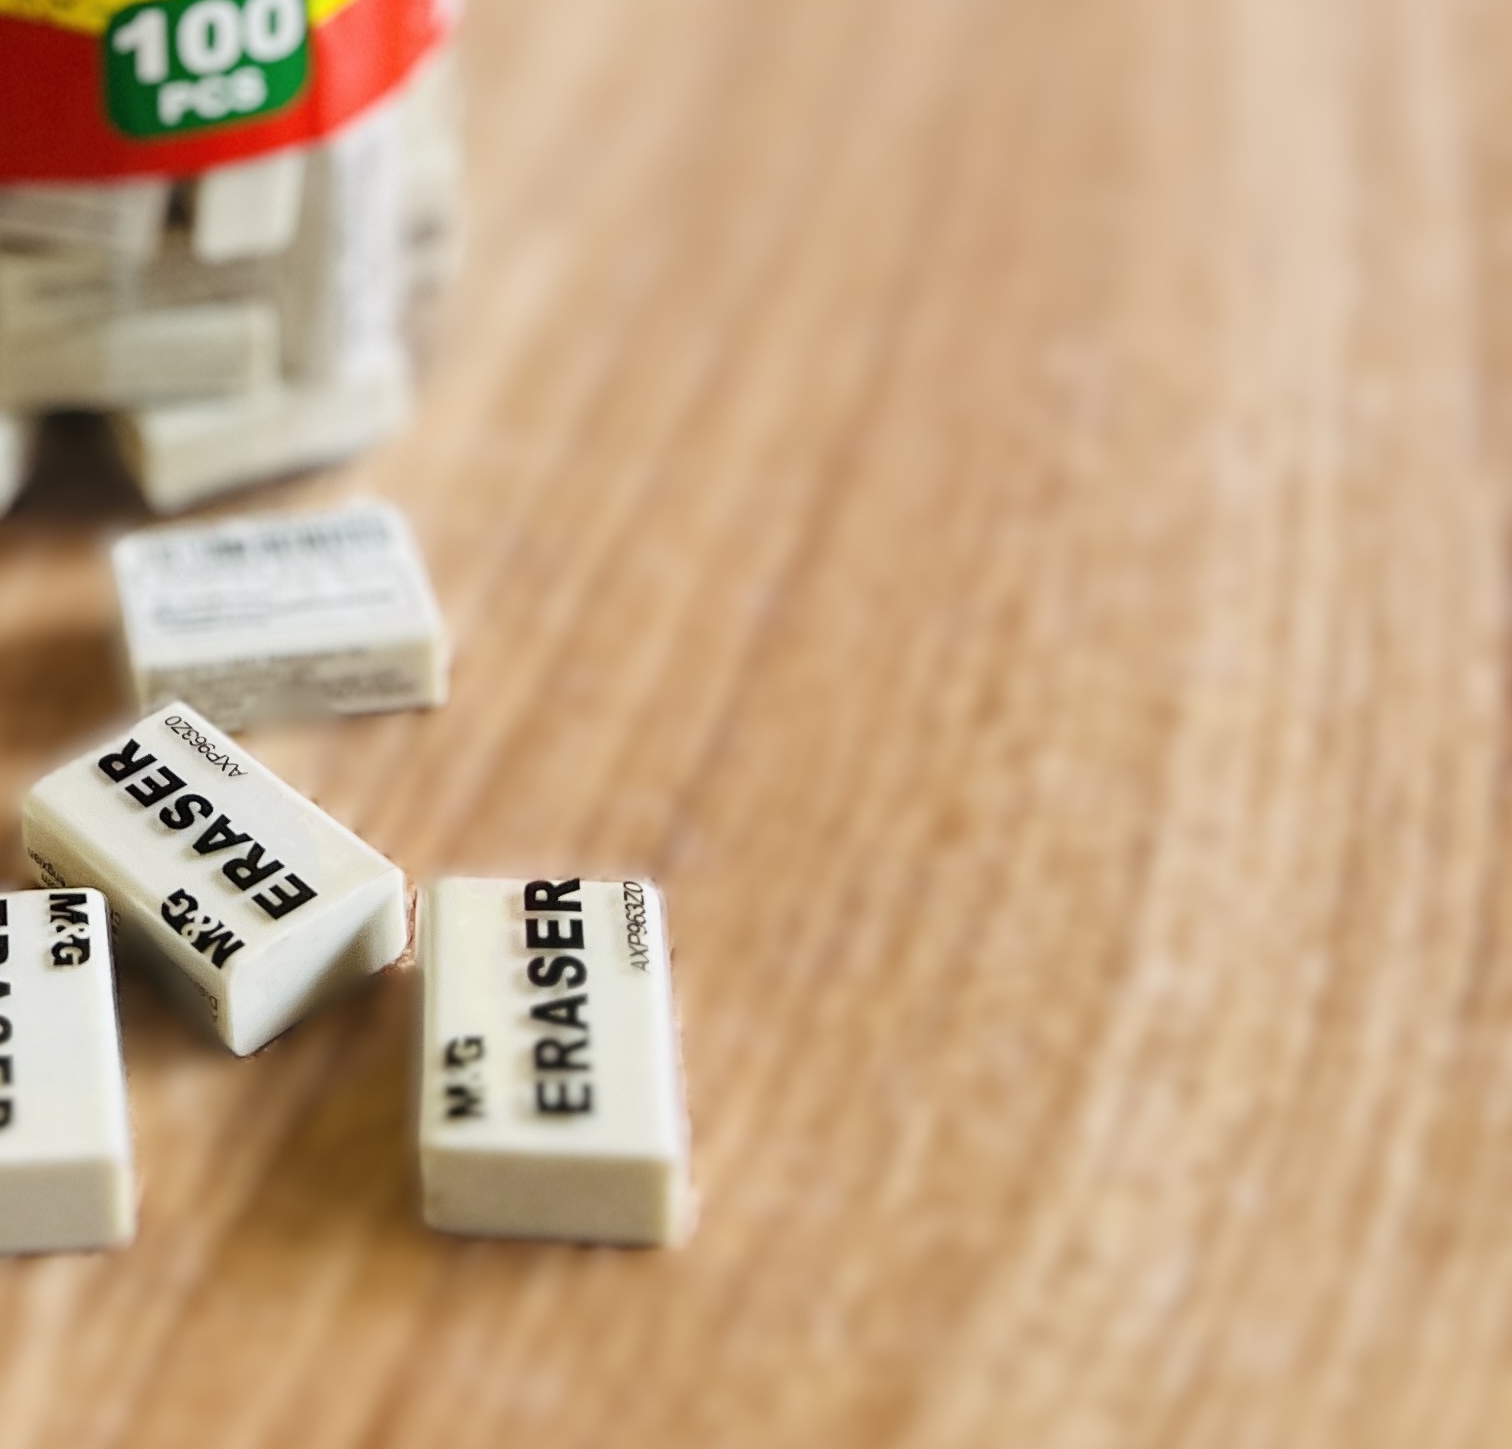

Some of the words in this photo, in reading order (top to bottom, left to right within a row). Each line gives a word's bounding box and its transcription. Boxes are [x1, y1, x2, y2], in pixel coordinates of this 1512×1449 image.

[164, 714, 249, 778] AXP963Z0
[97, 737, 319, 921] ERASER
[49, 893, 91, 966] M&G
[161, 887, 246, 970] M&G
[524, 877, 593, 1116] ERASER
